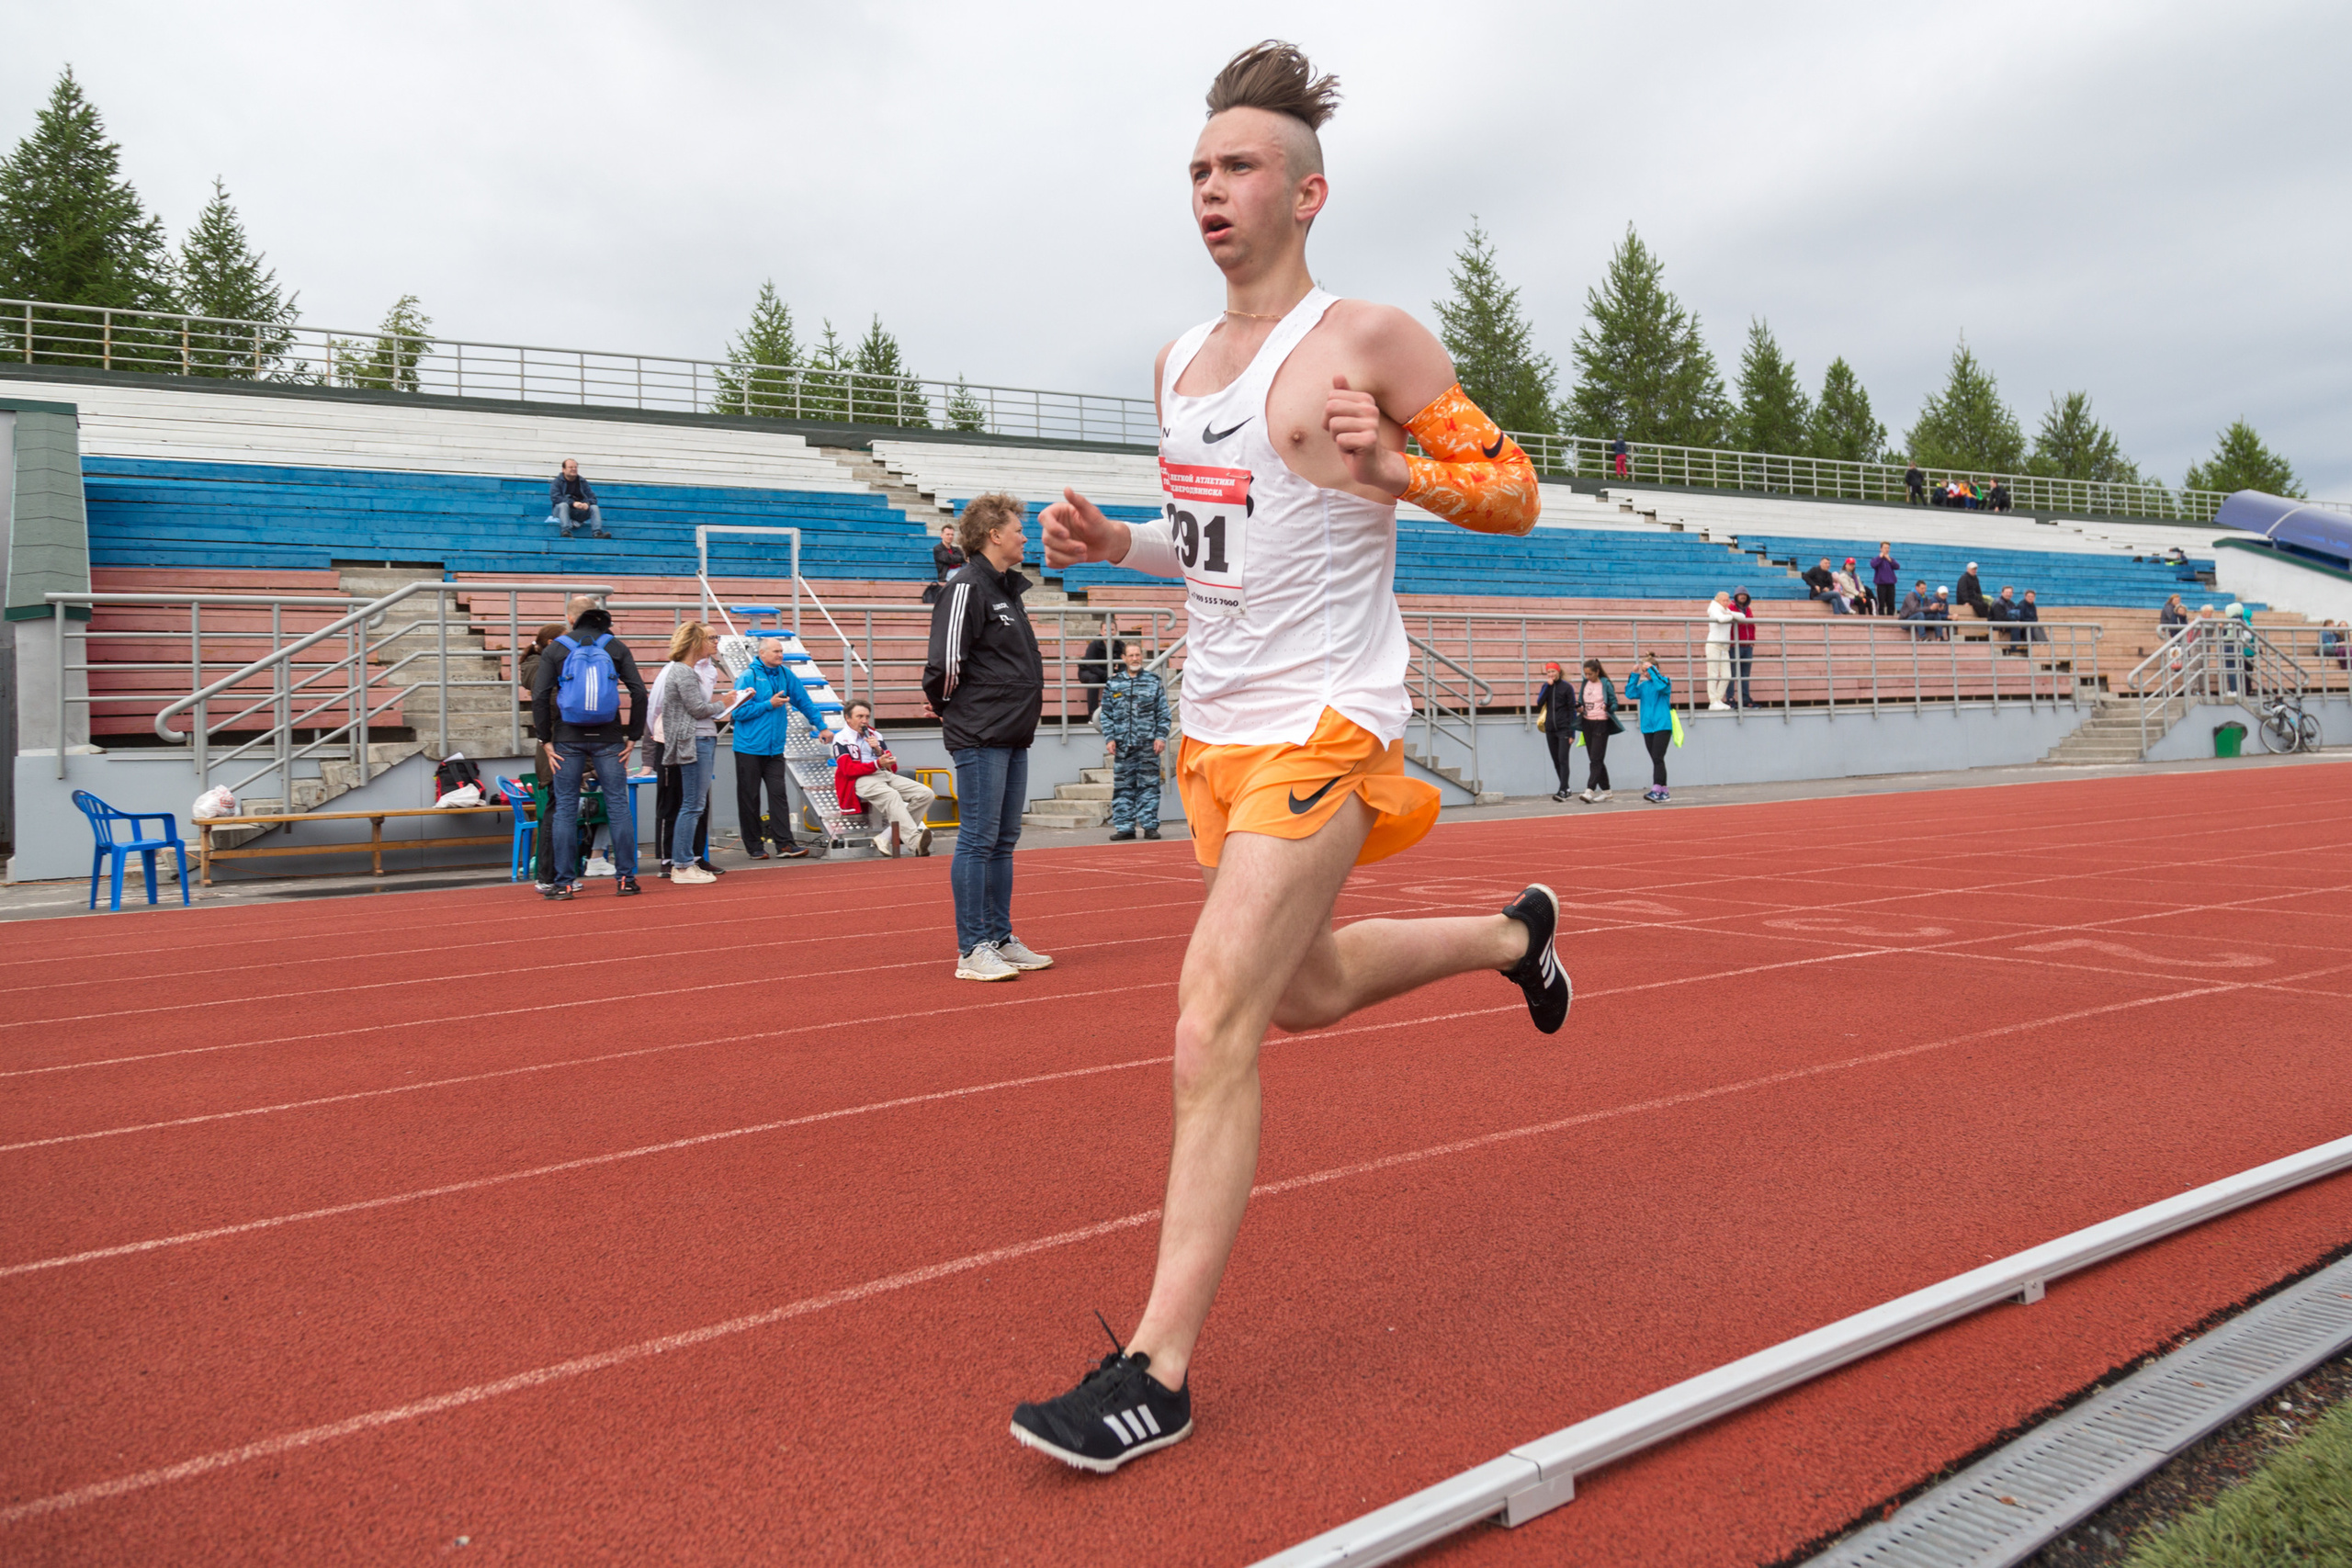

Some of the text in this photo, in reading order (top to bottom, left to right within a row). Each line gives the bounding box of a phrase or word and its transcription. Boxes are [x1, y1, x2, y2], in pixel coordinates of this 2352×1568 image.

[1195, 476, 1235, 486] АТЛЕТИКИ
[1166, 502, 1229, 573] 291
[1219, 598, 1238, 606] 7000
[1762, 919, 1955, 937] 3
[2009, 938, 2276, 967] 2
